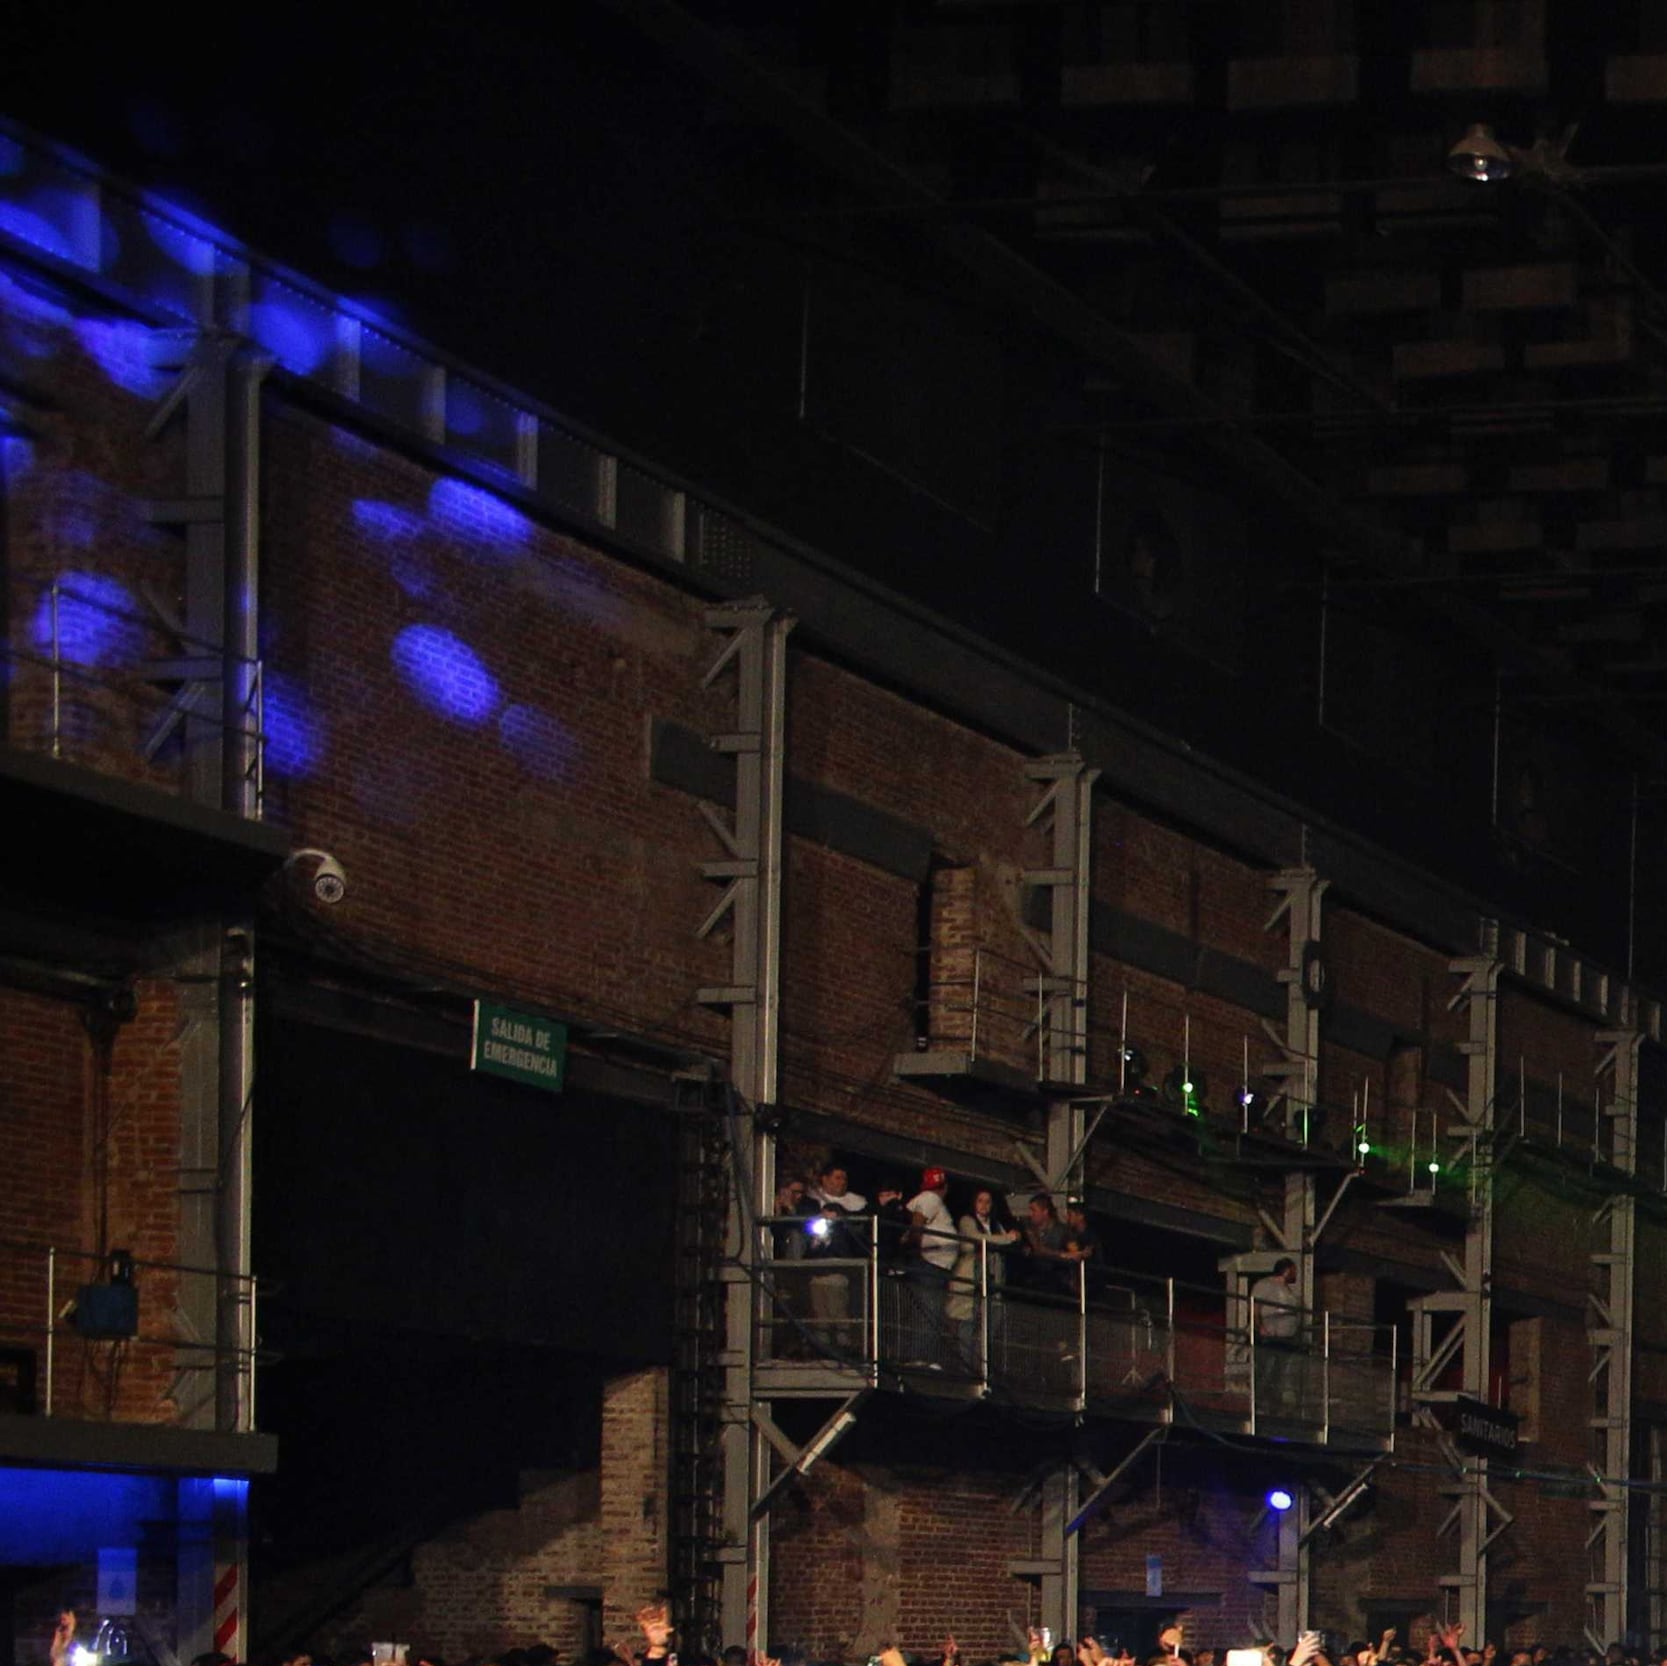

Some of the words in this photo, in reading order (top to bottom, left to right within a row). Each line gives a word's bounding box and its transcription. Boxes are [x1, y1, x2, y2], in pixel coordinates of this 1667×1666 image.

[491, 1017, 533, 1047] SALIDA
[535, 1030, 551, 1051] DE
[484, 1040, 557, 1078] EMERGENCIA
[1461, 1413, 1516, 1449] SANITARIOS
